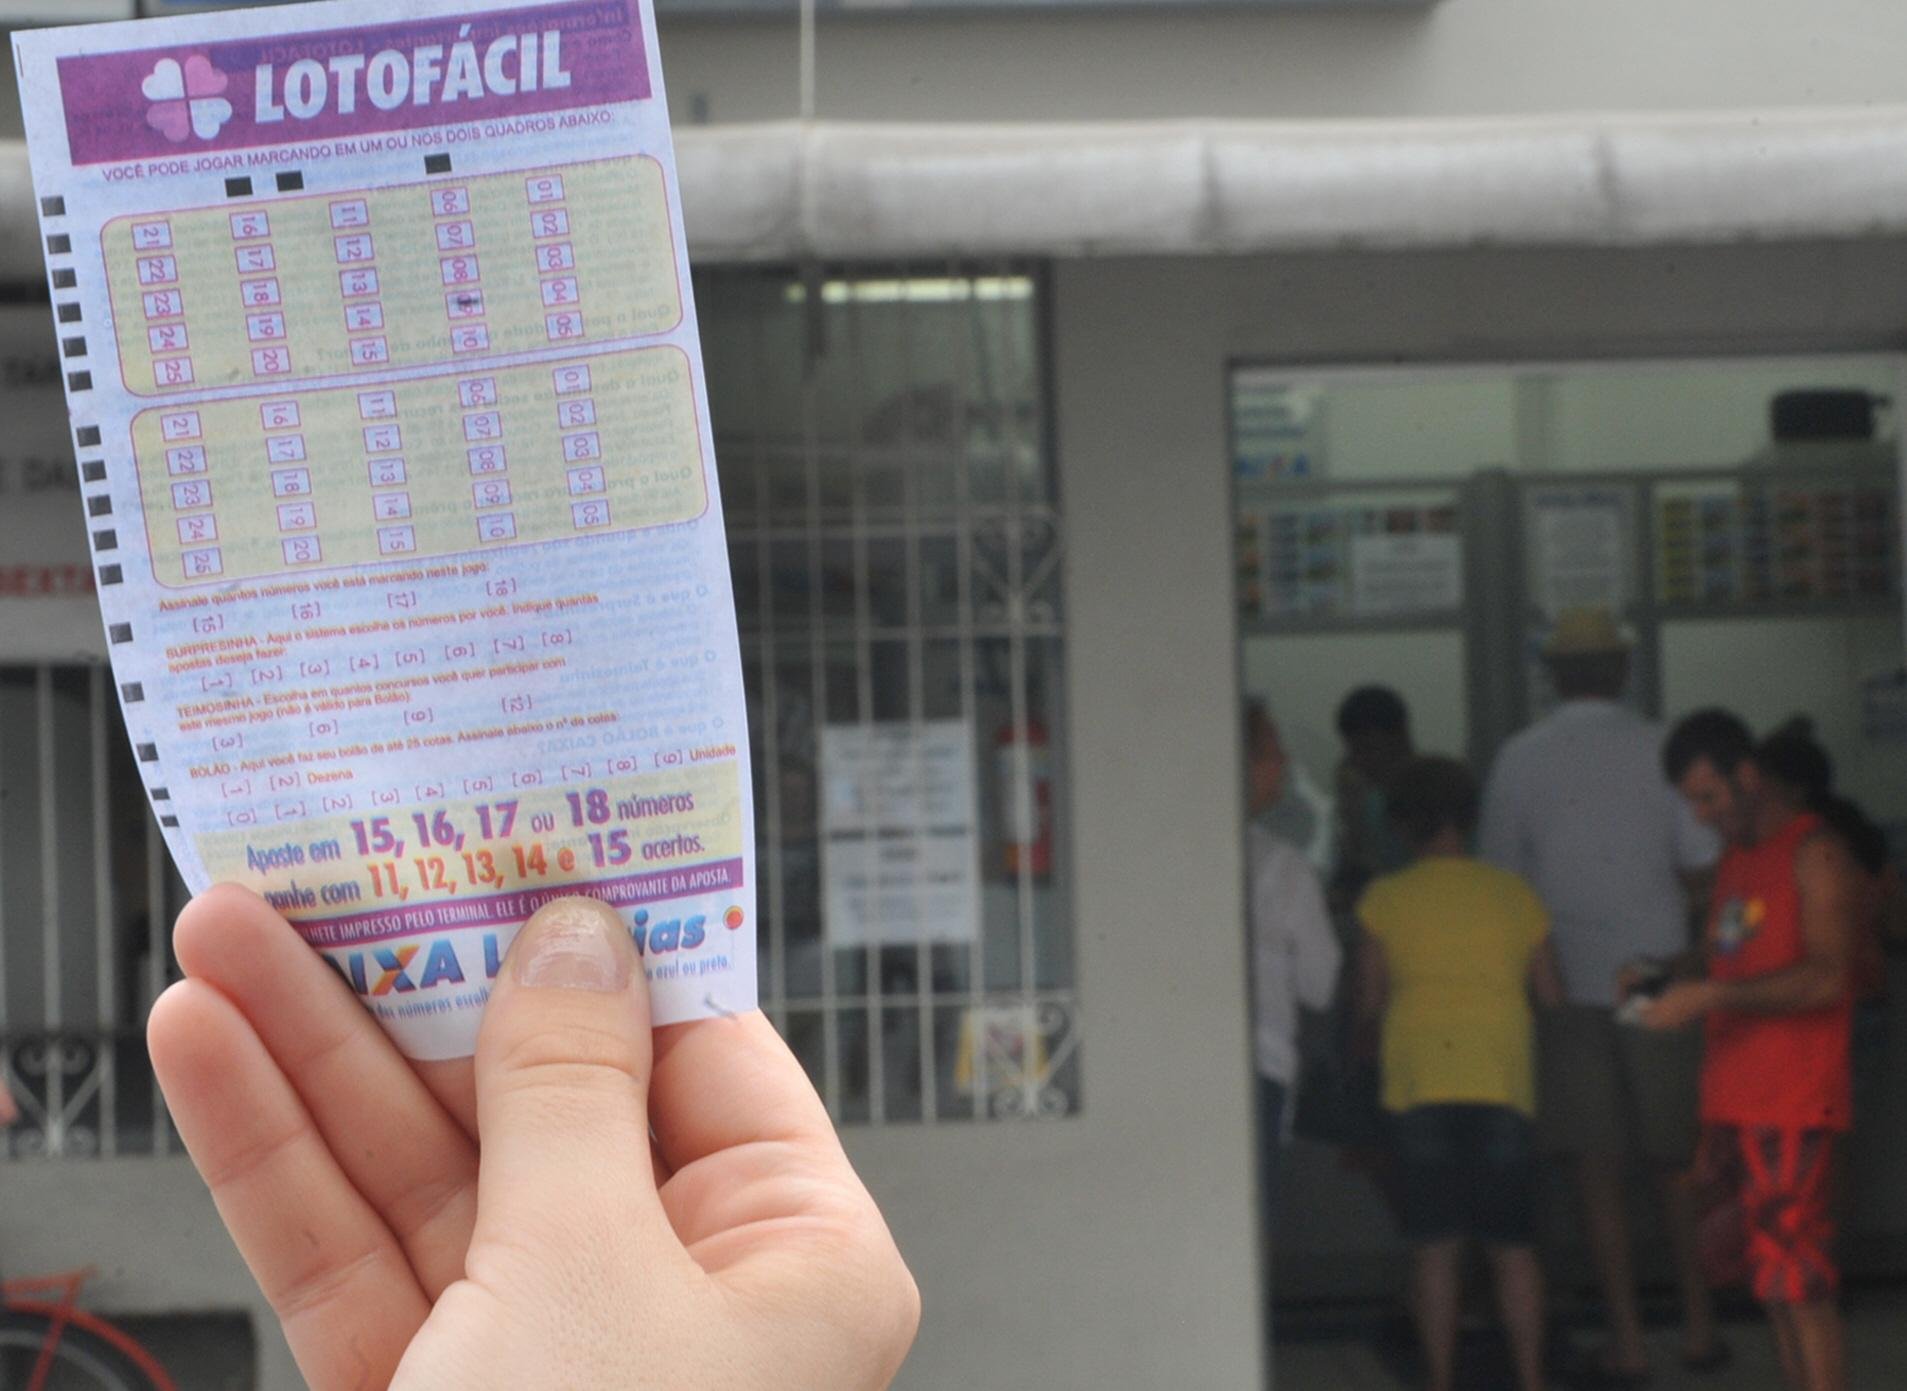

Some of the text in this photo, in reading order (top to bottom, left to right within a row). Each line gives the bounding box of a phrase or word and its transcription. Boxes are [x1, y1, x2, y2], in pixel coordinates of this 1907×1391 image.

[254, 24, 571, 124] LOTOFÁCIL
[102, 110, 615, 182] VOCÊ PODE JOGAR MARCANDO EM UM OU NOS DOIS QUADROS ABAIXO:
[242, 216, 280, 371] 16 17 18 19 20
[341, 206, 378, 361] 11 12 13 14 15
[442, 190, 478, 349] 06 07 08 10
[537, 179, 573, 337] 01 02 03 04 05
[143, 227, 182, 383] 21 22 23 24 25
[272, 405, 310, 561] 16 17 18 19 20
[370, 396, 406, 550] 11 12 13 14 15
[469, 382, 505, 537] 06 07 08 09 10
[564, 371, 599, 525] 01 02 03 04 05
[172, 418, 212, 574] 21 22 23 24 25
[159, 593, 209, 612] Assinale
[211, 587, 258, 605] quantos
[261, 579, 311, 598] números
[313, 577, 340, 590] você
[343, 573, 366, 588] está
[369, 570, 424, 586] marcando
[426, 565, 459, 578] neste
[166, 636, 258, 659] SURPRESINHA
[267, 630, 291, 646] Aqui
[294, 632, 302, 641] o
[305, 622, 347, 639] sistema
[393, 620, 406, 629] os
[409, 613, 456, 629] números
[459, 611, 477, 623] por
[512, 596, 552, 614] Indique
[555, 593, 599, 611] quantas
[168, 656, 212, 674] apostas
[215, 652, 253, 667] deseja
[176, 696, 254, 718] TEIMOSINHA
[311, 689, 327, 699] em
[330, 682, 373, 700] quantos
[375, 673, 429, 691] concursos
[432, 672, 458, 684] você
[461, 668, 485, 682] quer
[489, 661, 539, 679] participar
[542, 657, 566, 669] com
[179, 720, 202, 732] este
[205, 713, 246, 728] mesmo
[250, 710, 273, 726] jogo
[348, 695, 372, 709] para
[189, 763, 231, 779] BOLÃO
[240, 756, 265, 773] Aqui
[268, 753, 295, 768] você
[299, 751, 314, 762] faz
[317, 749, 336, 760] seu
[339, 742, 368, 758] bolão
[371, 743, 384, 754] de
[387, 738, 404, 752] até
[407, 738, 421, 750] 25
[457, 727, 504, 744] Assinale
[507, 721, 544, 736] abaixo
[546, 722, 554, 731] o
[571, 715, 585, 727] de
[307, 769, 354, 785] Dezena
[689, 744, 736, 762] Unidade
[246, 787, 695, 876] Aposte em 15, 16, 17 ou 18 números
[320, 880, 362, 906] com
[367, 860, 409, 901] 11,
[414, 855, 457, 895] 12,
[462, 849, 504, 889] 13,
[512, 842, 548, 879] 14
[558, 847, 576, 872] e
[588, 828, 632, 869] 15
[640, 834, 705, 862] acertos.
[339, 915, 400, 942] IMPRESSO
[404, 908, 435, 930] PELO
[438, 902, 494, 926] TERMINAL.
[497, 900, 515, 918] ELE
[519, 897, 526, 915] É
[671, 875, 686, 891] DA
[323, 938, 465, 996] IXA
[682, 961, 697, 976] ou
